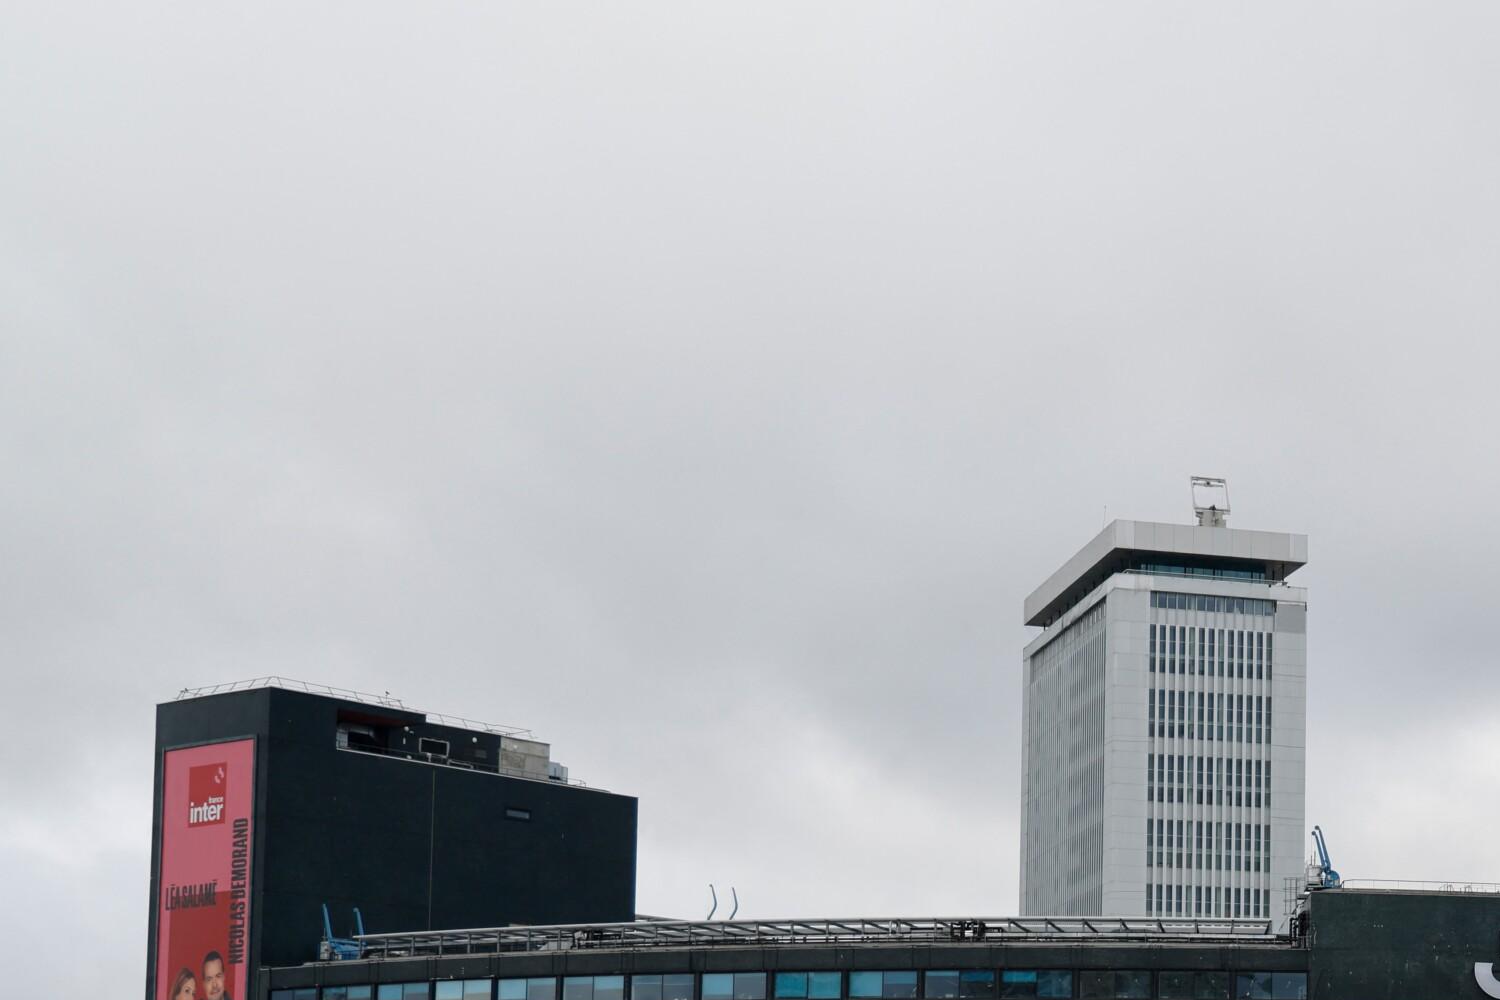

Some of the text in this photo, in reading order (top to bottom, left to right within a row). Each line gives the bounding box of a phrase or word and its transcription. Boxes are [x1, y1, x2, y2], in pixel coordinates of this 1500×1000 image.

[189, 802, 224, 824] inter
[229, 818, 249, 963] NICOLAS DEMORAND
